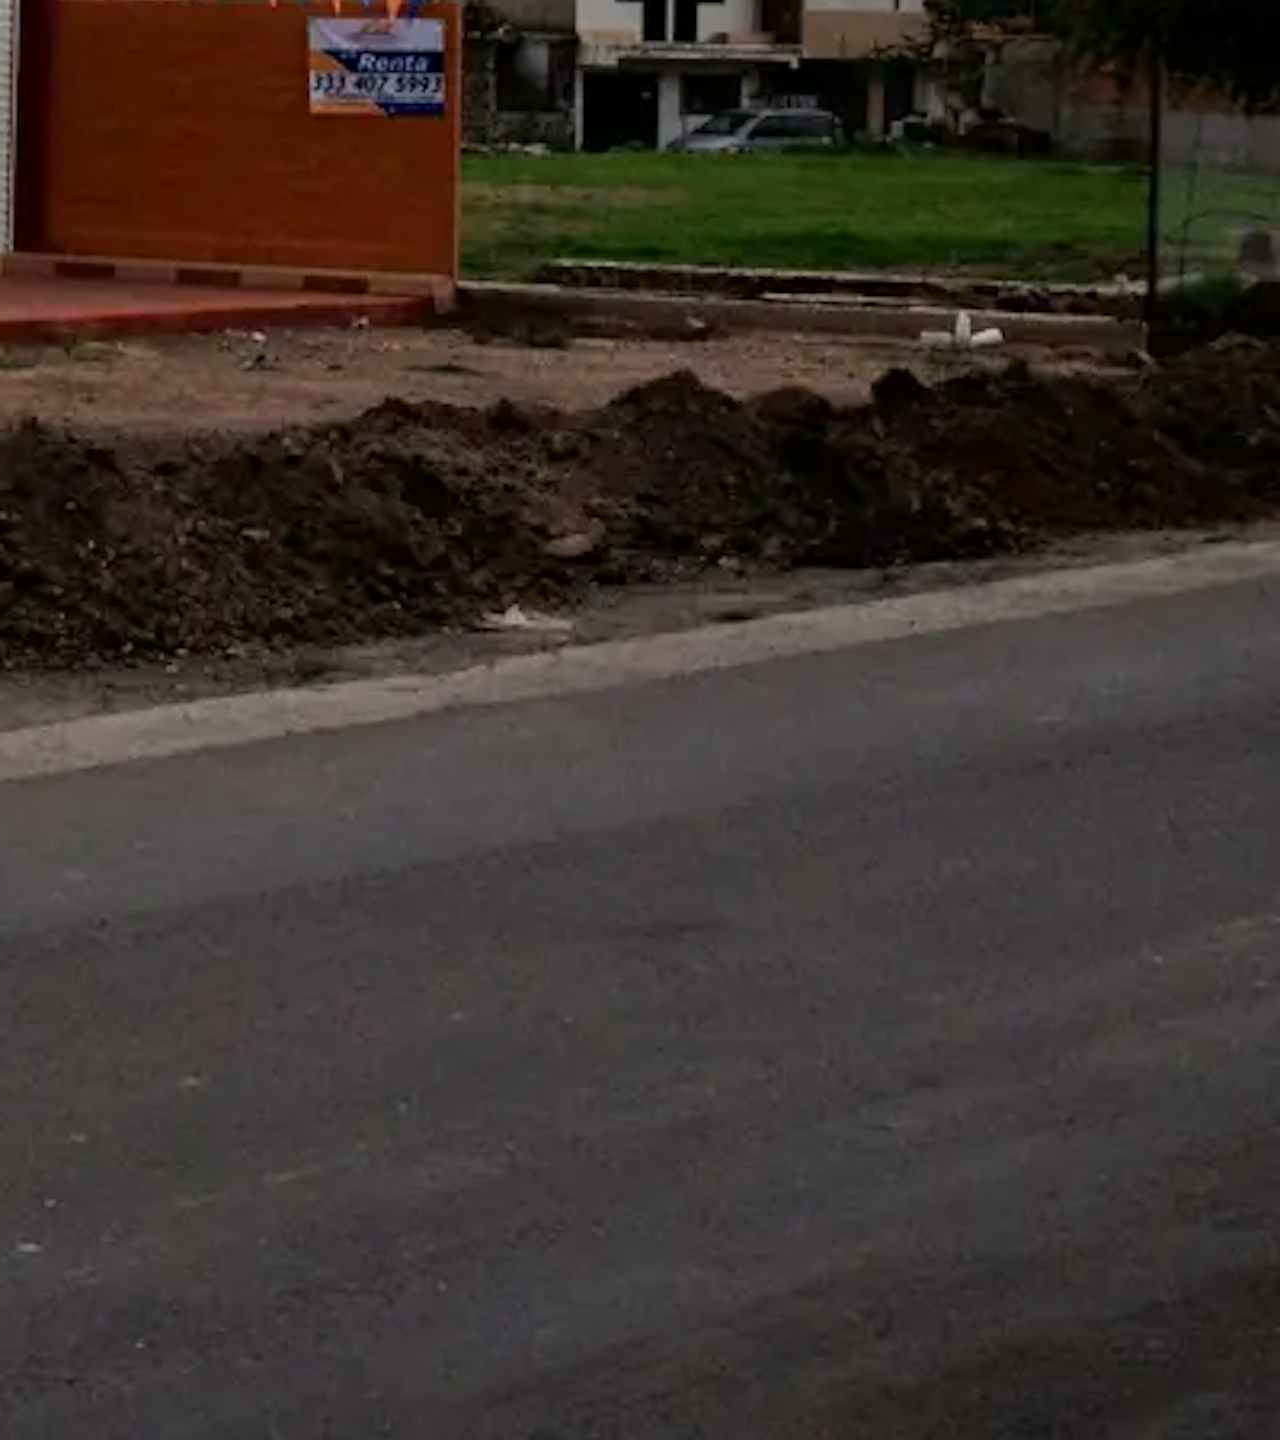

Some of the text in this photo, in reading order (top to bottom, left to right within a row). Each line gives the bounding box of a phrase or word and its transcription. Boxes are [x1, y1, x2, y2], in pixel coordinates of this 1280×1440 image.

[358, 52, 428, 73] Renta
[352, 73, 388, 95] 407
[394, 73, 441, 95] 5993
